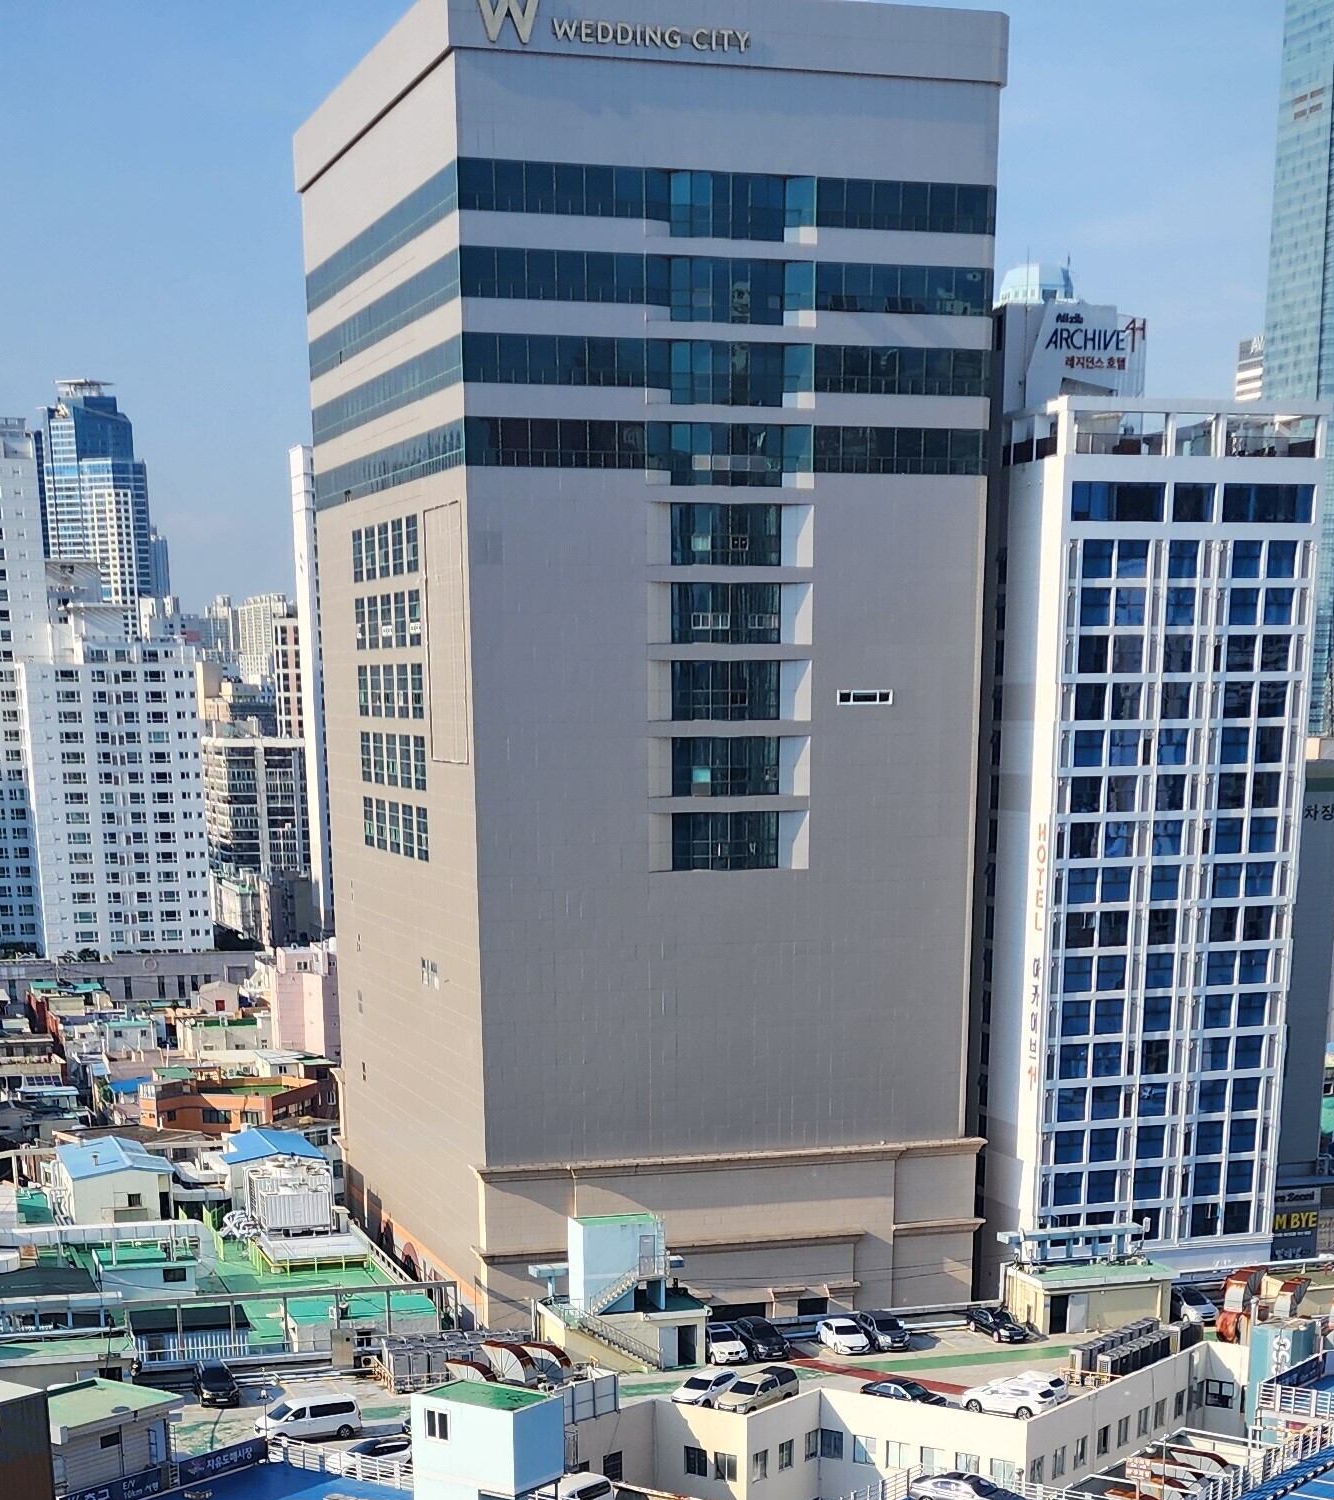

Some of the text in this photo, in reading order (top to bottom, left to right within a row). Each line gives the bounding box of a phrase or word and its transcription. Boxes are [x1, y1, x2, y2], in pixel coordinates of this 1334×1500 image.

[478, 0, 540, 44] W
[552, 17, 751, 53] WEDDING CITY
[1045, 327, 1126, 352] ARCHIVE
[1105, 356, 1127, 371] 호텔
[1290, 1211, 1318, 1229] BYE
[205, 1446, 253, 1470] 자유도매시장
